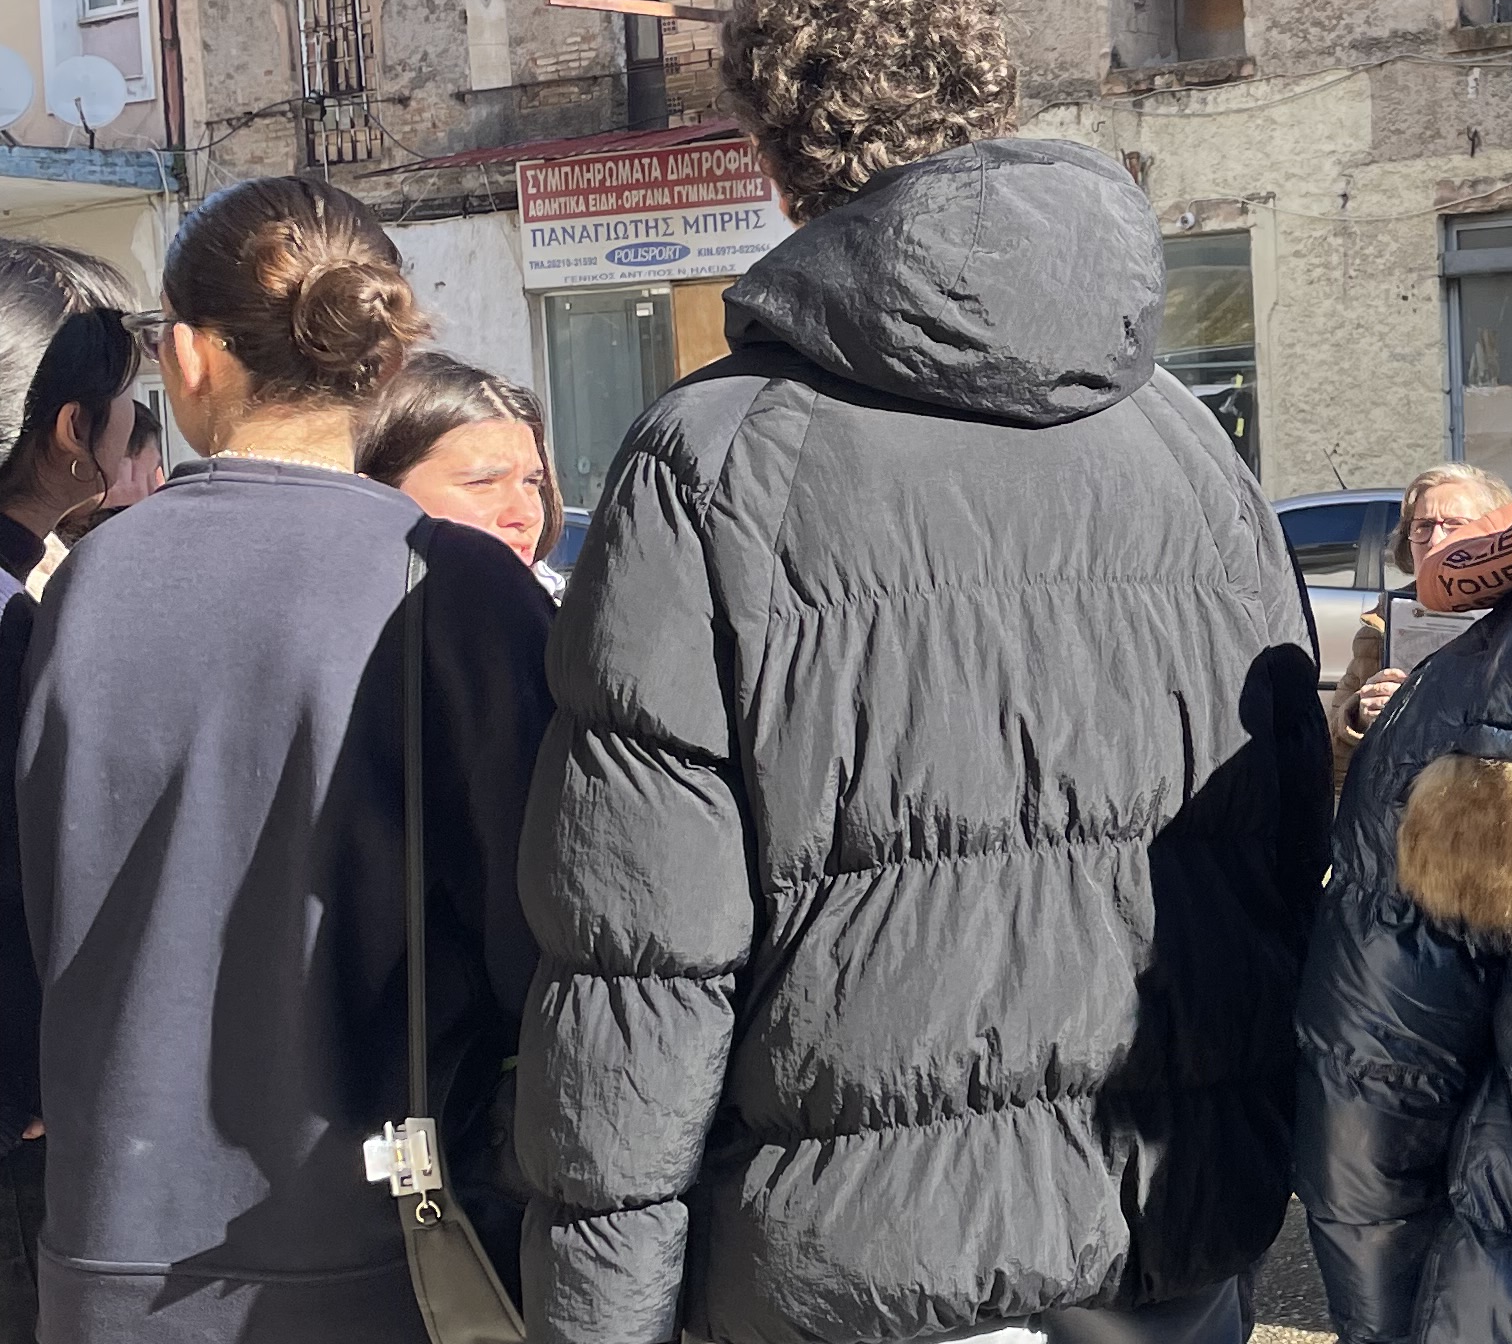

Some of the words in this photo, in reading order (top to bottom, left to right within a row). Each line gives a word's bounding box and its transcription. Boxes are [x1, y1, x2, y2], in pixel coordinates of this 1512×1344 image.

[525, 156, 662, 194] ΣΥΜΠΛΗΡΩΜΑΤΑ
[529, 196, 586, 217] ΑΘΛΗΤΙΚΑ
[674, 178, 765, 204] ΓΥΜΝΑΣΤΙΚΗΣ
[530, 216, 675, 248] ΠΑΝΑΓΙΩΤΗΣ
[682, 208, 766, 235] ΜΠΡΗΣ
[614, 245, 682, 264] POLISPORT
[563, 271, 616, 284] ΓΕΝΙΚΟΣ
